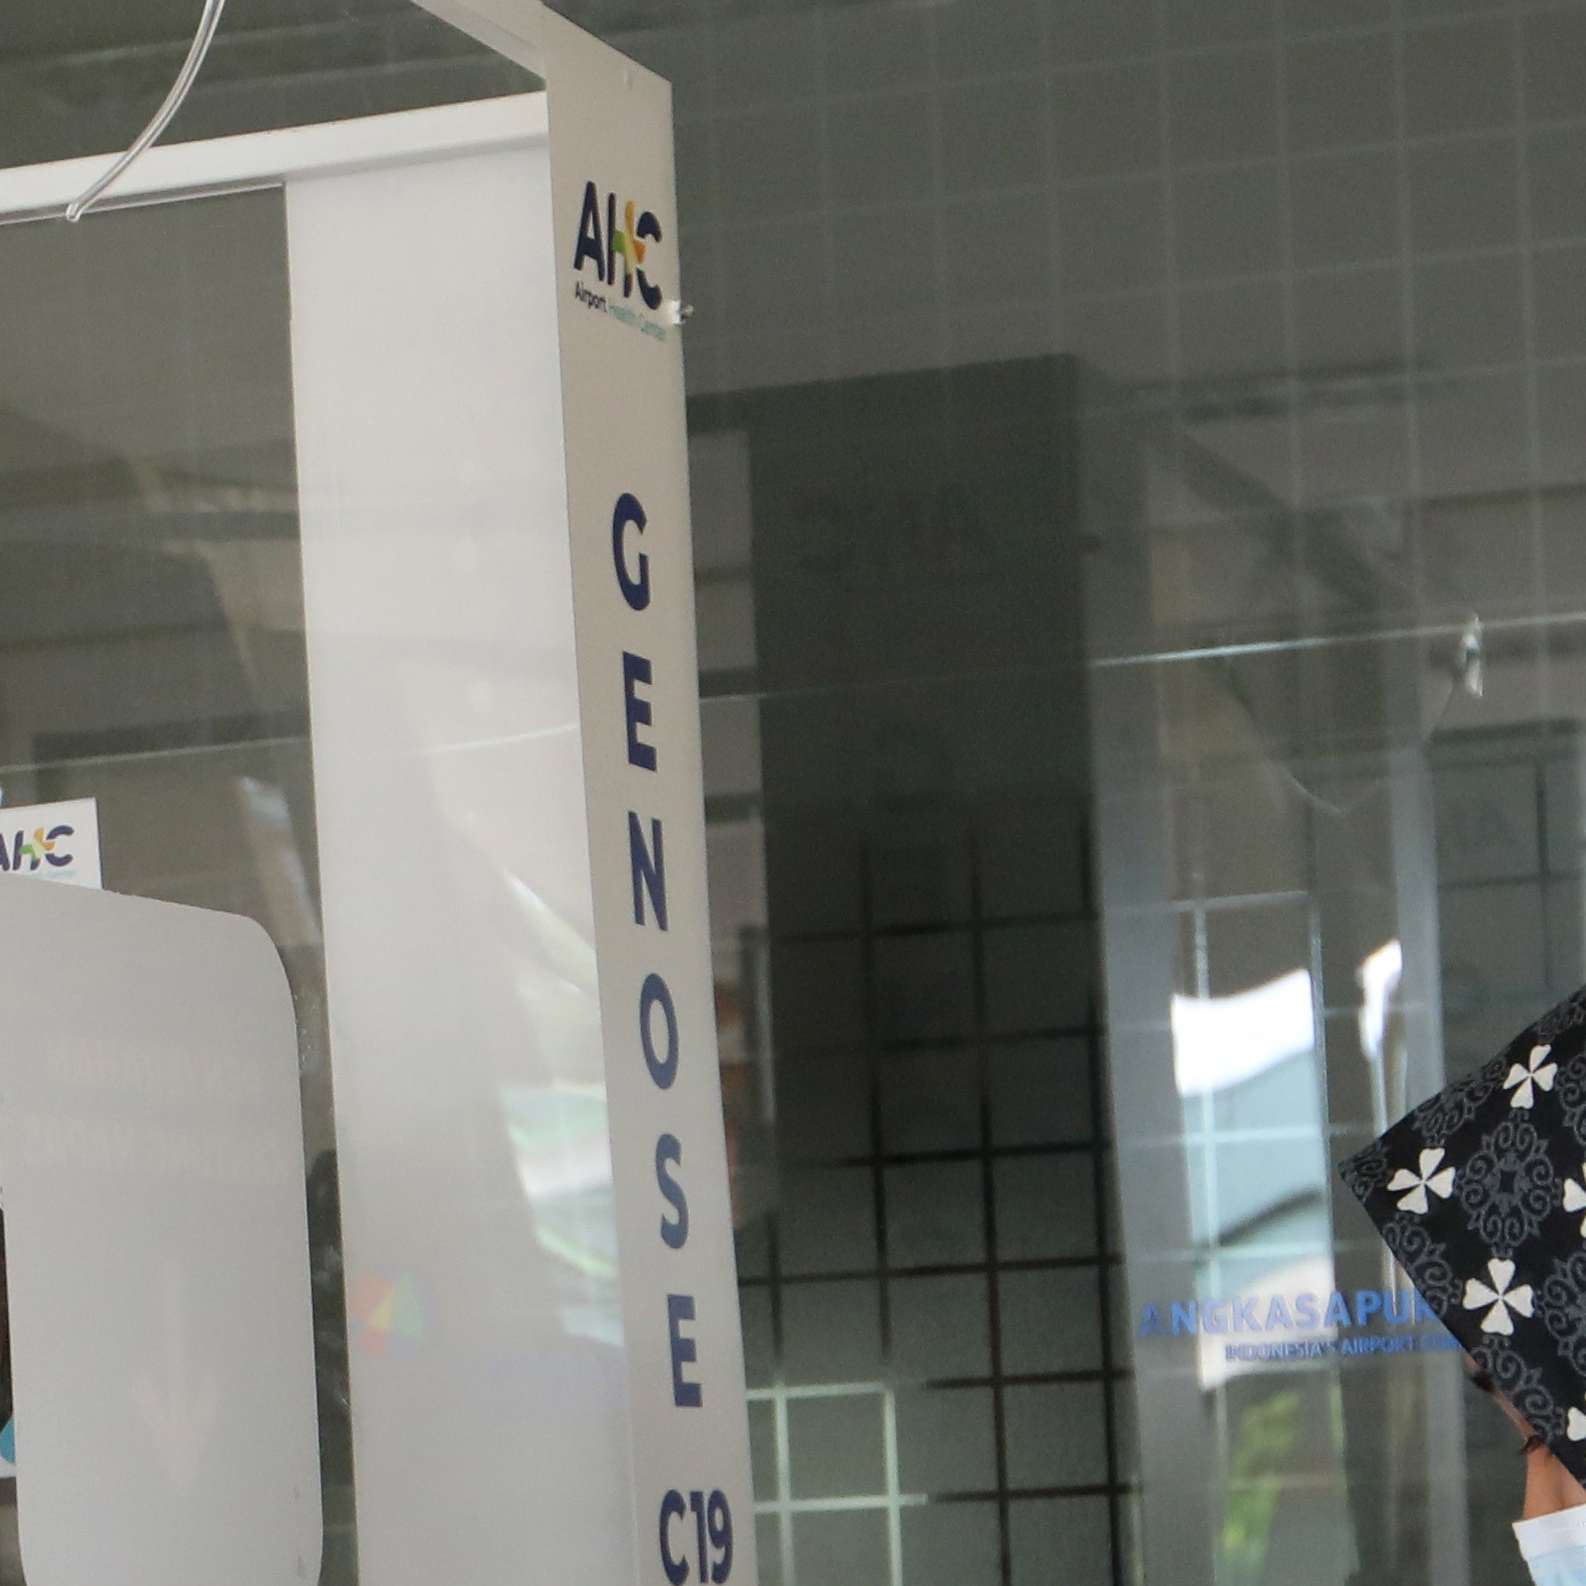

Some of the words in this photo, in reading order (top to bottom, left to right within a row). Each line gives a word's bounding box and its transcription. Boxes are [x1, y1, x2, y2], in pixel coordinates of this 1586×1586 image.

[574, 180, 662, 310] AHC
[574, 281, 607, 312] Airport
[613, 492, 703, 1408] GENOSE
[1340, 1333, 1414, 1357] AIRPORT
[660, 1488, 734, 1586] C19
